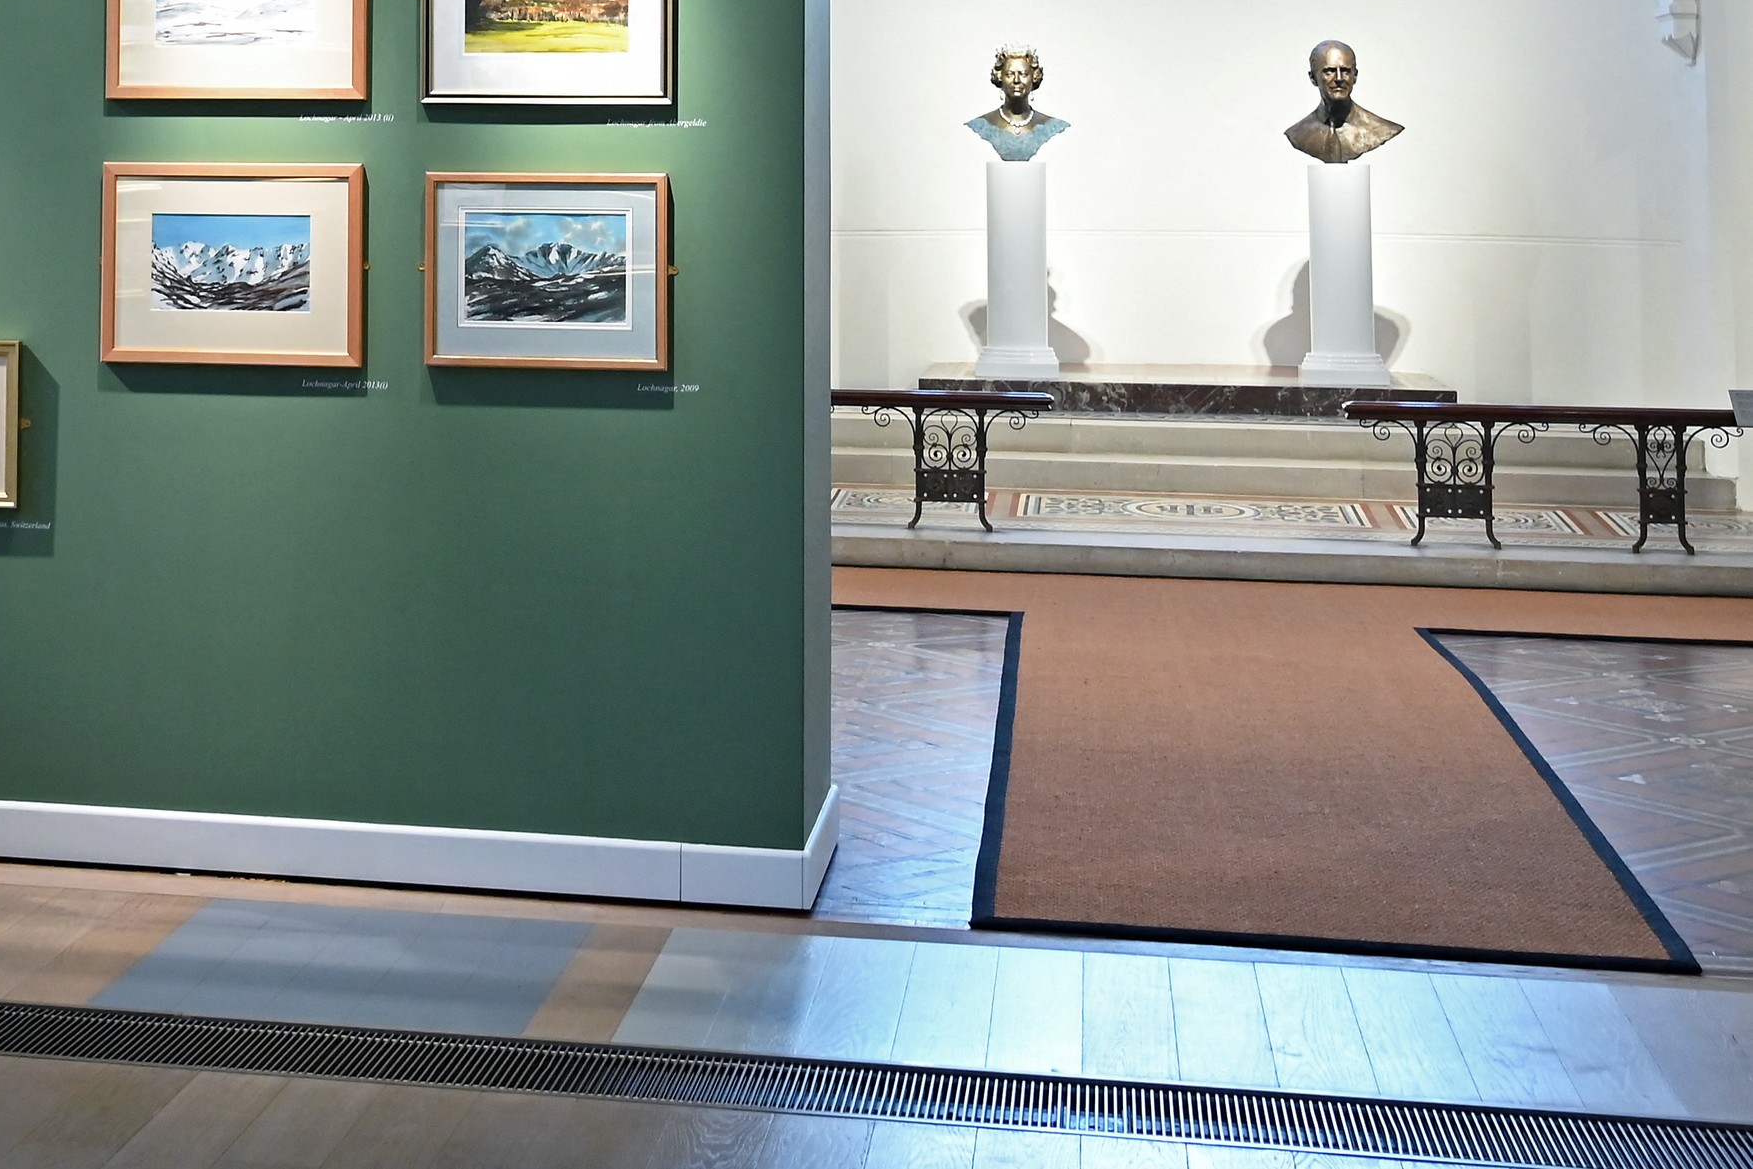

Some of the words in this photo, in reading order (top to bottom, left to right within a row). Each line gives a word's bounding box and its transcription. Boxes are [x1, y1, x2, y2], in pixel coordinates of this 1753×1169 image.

[298, 114, 336, 123] Lochnagar
[343, 114, 362, 123] April
[363, 113, 382, 122] 2013
[637, 383, 678, 393] Lochnagar,
[680, 384, 700, 392] 2009
[10, 520, 51, 530] Switzerland
